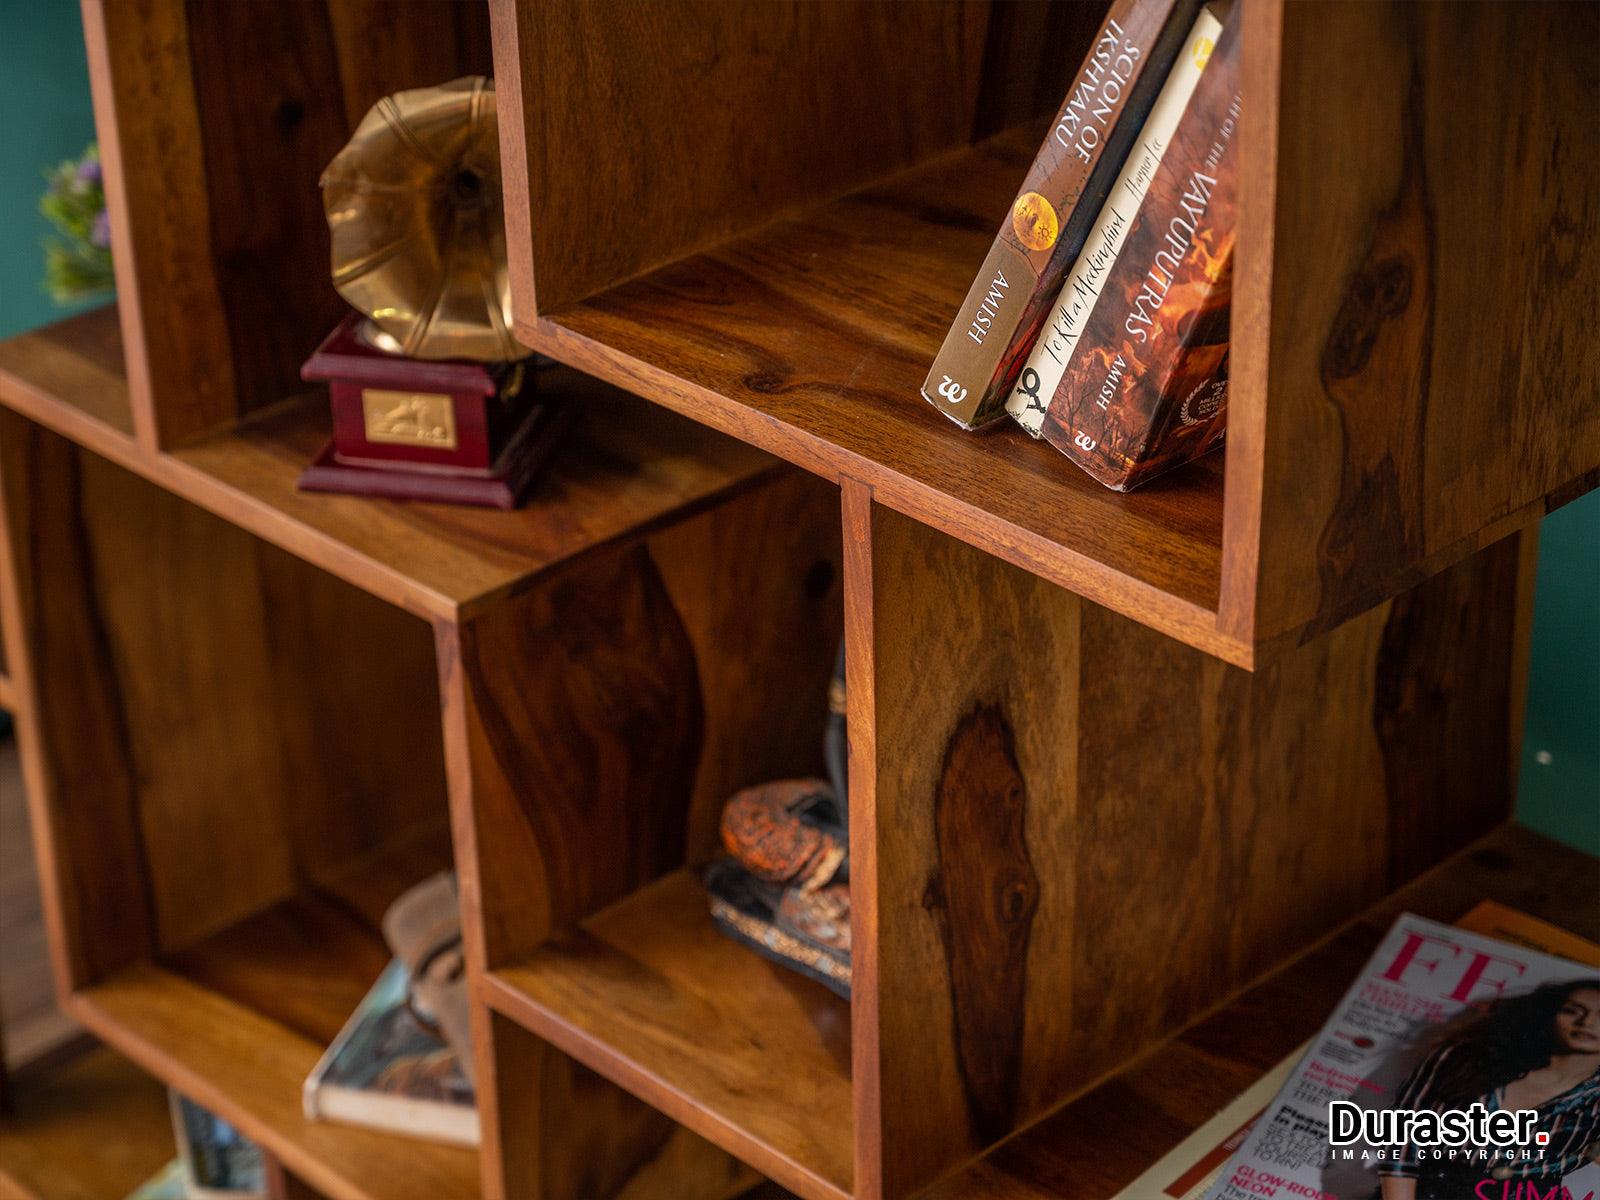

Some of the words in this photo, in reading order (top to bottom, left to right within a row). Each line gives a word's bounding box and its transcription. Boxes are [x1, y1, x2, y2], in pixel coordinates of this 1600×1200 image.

[1055, 19, 1124, 148] IKSHVAKU
[1092, 39, 1141, 125] SCION
[1075, 125, 1099, 164] OF
[1073, 206, 1127, 309] Mockingbird
[1125, 171, 1217, 343] VAYUPUTRAS
[967, 270, 1010, 345] AMISH
[1053, 301, 1079, 344] Kill
[1071, 303, 1081, 316] a
[1041, 339, 1064, 366] To
[1096, 354, 1127, 411] AMISH
[1292, 1123, 1328, 1140] play
[1230, 1175, 1276, 1198] NEON
